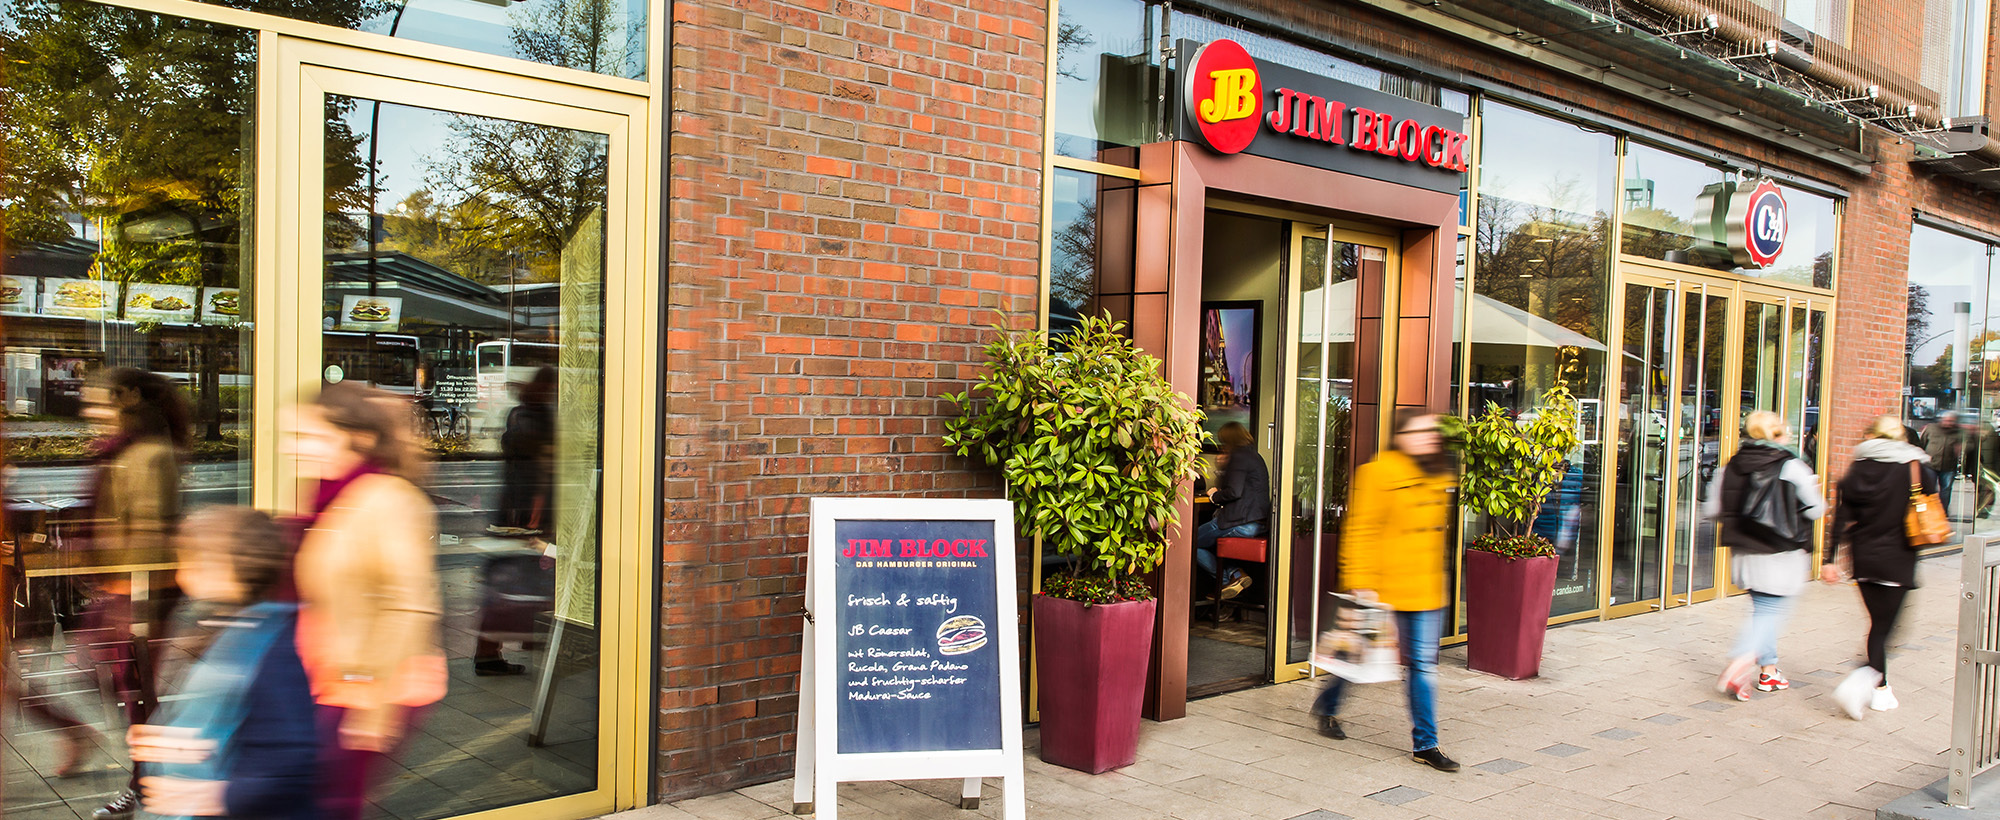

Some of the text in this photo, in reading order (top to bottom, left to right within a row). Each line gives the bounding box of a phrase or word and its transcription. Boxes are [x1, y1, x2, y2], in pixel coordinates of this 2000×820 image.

[1200, 68, 1257, 124] JB
[1266, 87, 1468, 173] JIM BLOCK
[1757, 204, 1785, 243] C&A
[842, 538, 989, 558] JIM BLOCK
[1556, 584, 1584, 596] canda.com
[847, 592, 958, 614] frisch & saftig
[847, 623, 913, 636] JB Caesar
[867, 647, 931, 659] Römersalat,
[848, 660, 969, 673] Rucola, Grana Padano
[847, 677, 868, 687] und
